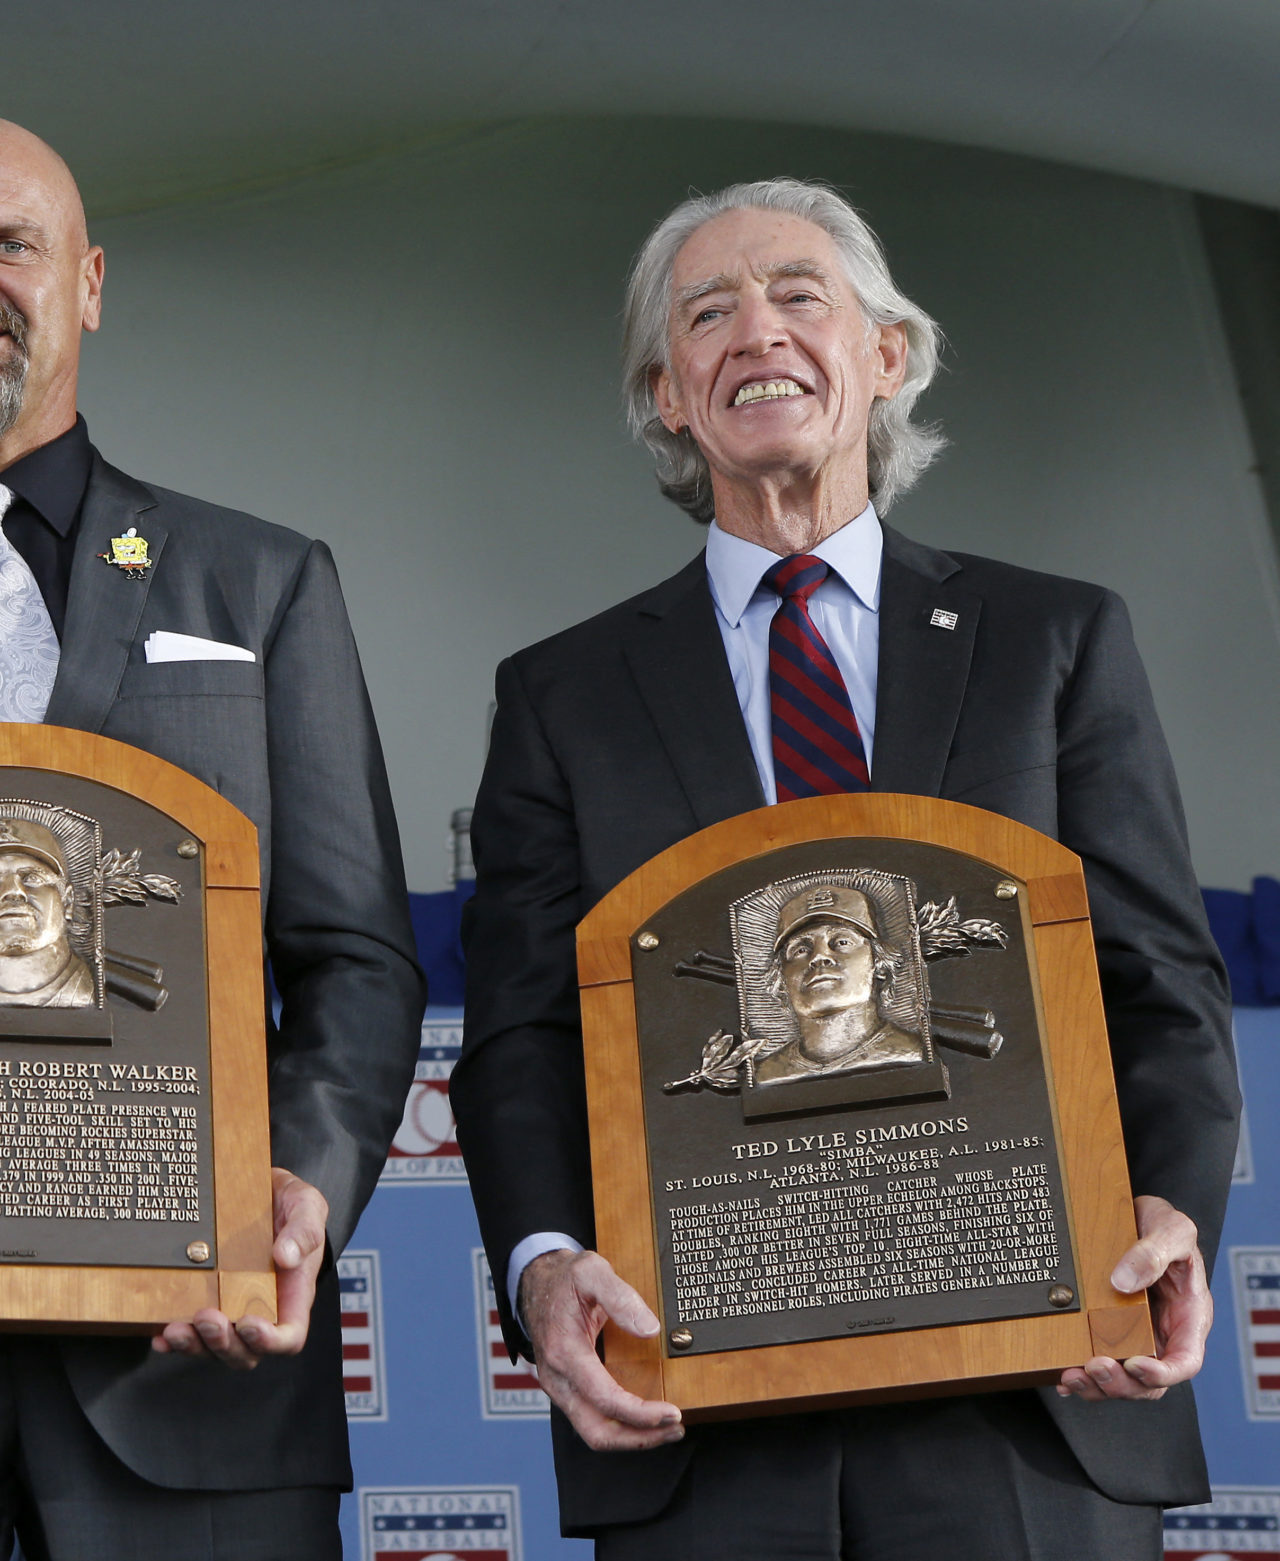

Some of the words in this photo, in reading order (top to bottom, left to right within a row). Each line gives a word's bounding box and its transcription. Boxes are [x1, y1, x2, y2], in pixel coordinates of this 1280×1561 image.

[8, 1078, 93, 1091] COLORADO,
[97, 1080, 125, 1091] N.L.
[19, 1062, 102, 1078] ROBERT
[110, 1064, 198, 1081] WALKER
[11, 1089, 40, 1099] N.L.
[43, 1090, 95, 1101] 2004-05
[11, 1102, 19, 1112] A
[24, 1102, 68, 1114] FEARED
[72, 1104, 107, 1115] PLATE
[111, 1105, 167, 1116] PRESENCE
[171, 1106, 197, 1117] WHO
[20, 1125, 77, 1136] BECOMING
[81, 1126, 128, 1138] ROCKIES
[131, 1128, 197, 1140] SUPERSTAR.
[731, 1140, 779, 1160] TED
[786, 1132, 847, 1153] LYLE
[854, 1117, 969, 1144] SIMMONS
[8, 1159, 59, 1170] AVERAGE
[64, 1160, 102, 1172] THREE
[107, 1162, 142, 1173] TIMES
[148, 1163, 161, 1173] IN
[168, 1163, 198, 1174] FOUR
[665, 1178, 687, 1190] ST.
[692, 1171, 742, 1188] LOUIS,
[747, 1167, 777, 1180] N.L.
[845, 1147, 944, 1170] MILWAUKEE,
[947, 1143, 979, 1156] A.L.
[769, 1170, 844, 1190] ATLANTA,
[849, 1166, 879, 1179] N.L.
[885, 1159, 940, 1175] 1986-88
[668, 1197, 761, 1218] TOUGH-AS-NAILS
[777, 1184, 869, 1205] SWITCH-HITTING
[887, 1176, 938, 1192] CATCHER
[955, 1169, 994, 1184] WHOSE
[1011, 1163, 1048, 1177] PLATE
[670, 1212, 739, 1230] PRODUCTION
[742, 1206, 782, 1221] PLACES
[784, 1203, 806, 1216] HIM
[808, 1202, 821, 1213] IN
[822, 1199, 845, 1211] THE
[848, 1194, 884, 1208] UPPER
[887, 1188, 938, 1204] ECHELON
[939, 1182, 980, 1197] AMONG
[983, 1174, 1049, 1192] BACKSTOPS.
[676, 1285, 708, 1299] HOME
[713, 1281, 745, 1294] RUNS.
[751, 1272, 818, 1290] CONCLUDED
[823, 1266, 867, 1281] CAREER
[872, 1264, 887, 1276] AS
[891, 1257, 945, 1273] ALL-TIME
[951, 1250, 1008, 1266] NATIONAL
[1013, 1244, 1059, 1259] LEAGUE
[678, 1307, 719, 1321] PLAYER
[722, 1299, 786, 1316] PERSONNEL
[787, 1295, 826, 1310] ROLES,
[828, 1287, 890, 1304] INCLUDING
[893, 1282, 939, 1297] PIRATES
[940, 1276, 994, 1292] GENERAL
[996, 1269, 1056, 1285] MANAGER.
